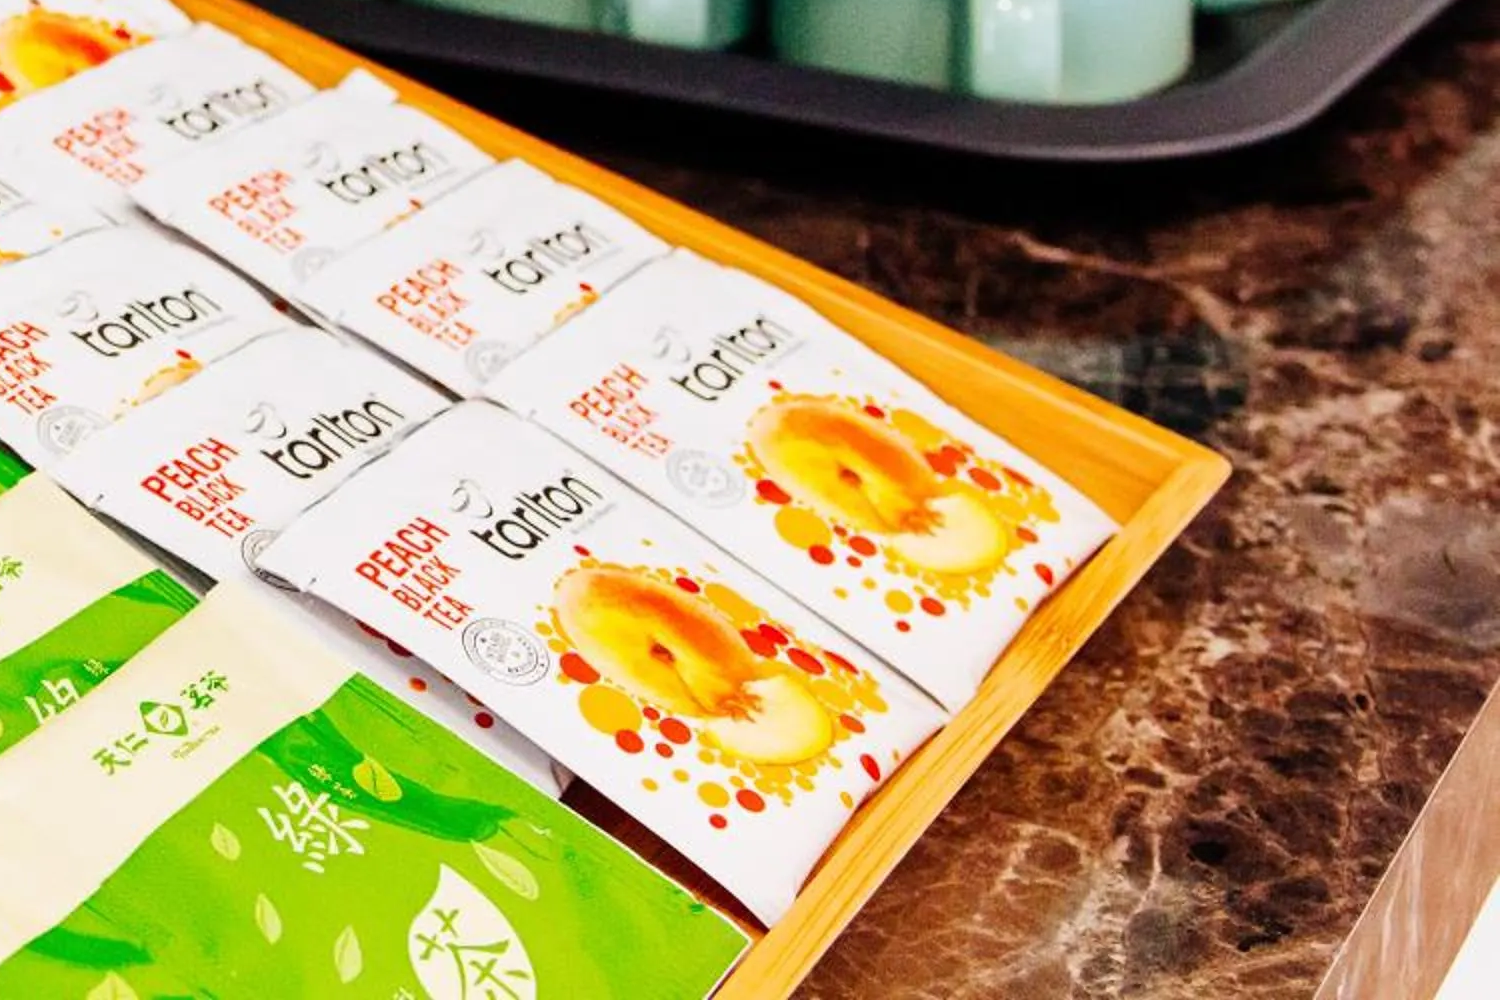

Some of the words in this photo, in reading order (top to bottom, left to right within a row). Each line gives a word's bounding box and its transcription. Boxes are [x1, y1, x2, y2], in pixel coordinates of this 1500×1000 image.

[377, 259, 463, 316] PEACH
[481, 222, 610, 294] tarlton
[71, 289, 221, 357] tarlton
[669, 319, 792, 402] tarlton
[7, 385, 58, 415] TEA
[570, 363, 649, 425] PEACH
[141, 437, 240, 503] PEACH
[260, 400, 405, 479] tarlton
[175, 474, 246, 521] BLACK
[205, 507, 255, 538] TEA
[469, 477, 603, 560] tarlton
[355, 517, 451, 591] PEACH
[392, 555, 461, 613] BLACK
[423, 595, 475, 630] TEA
[92, 732, 149, 776] 天仁
[257, 781, 370, 873] 綠
[414, 908, 532, 1000] 茶
